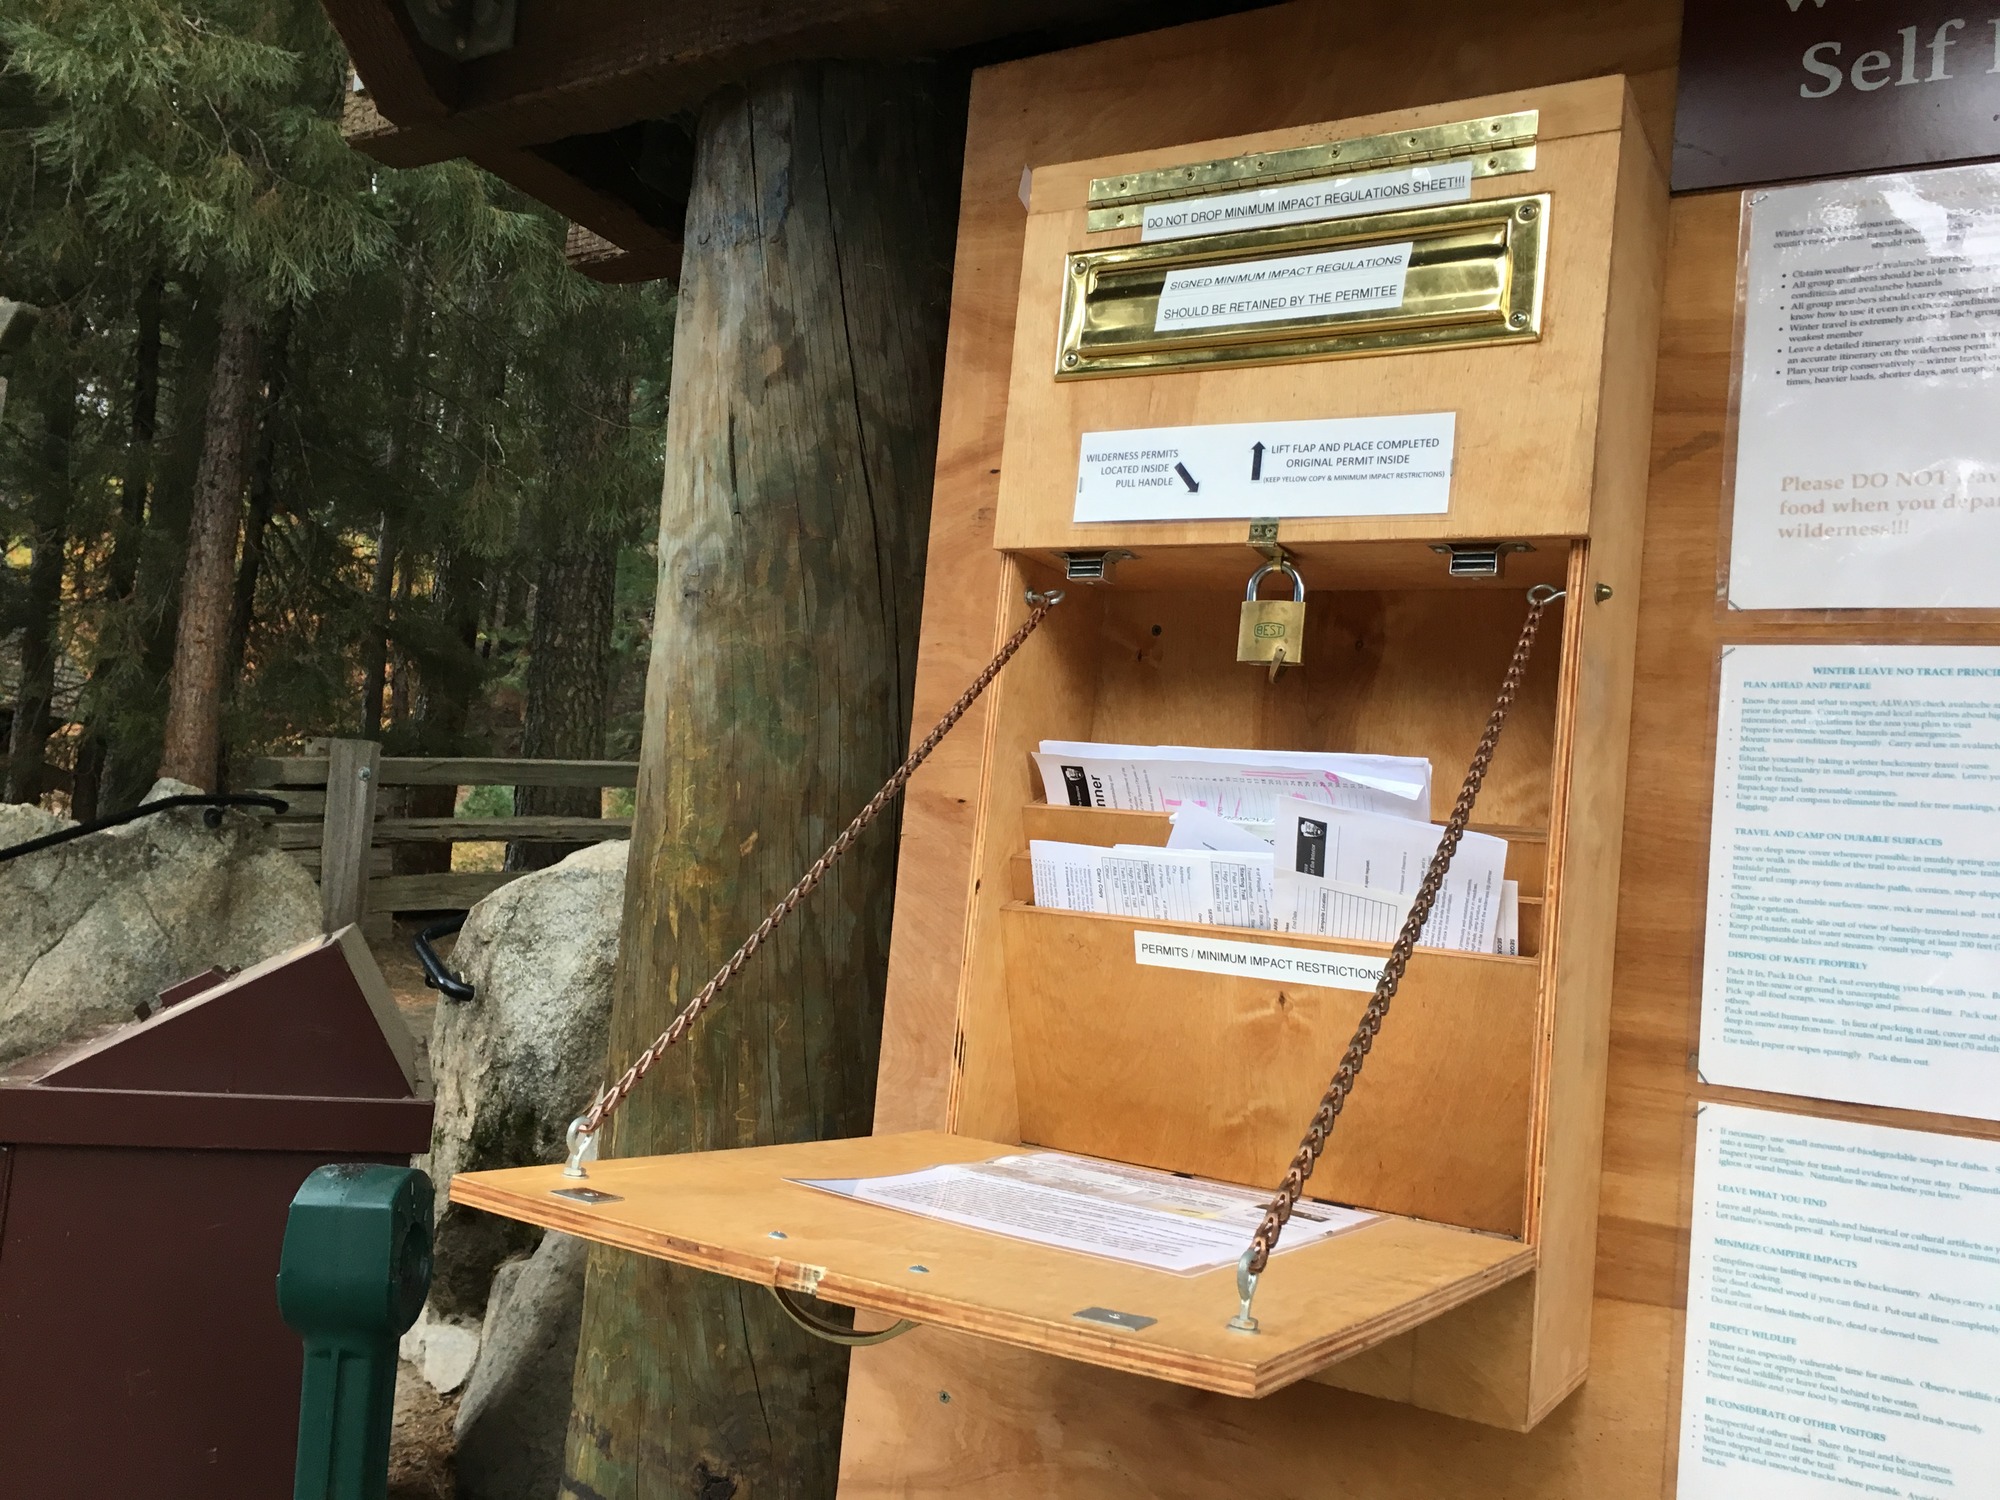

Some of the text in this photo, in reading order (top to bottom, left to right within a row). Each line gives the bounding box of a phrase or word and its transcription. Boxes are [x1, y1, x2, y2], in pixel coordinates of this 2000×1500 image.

[1800, 18, 1965, 98] Self
[1148, 176, 1465, 229] DO NOT DROP MINIMUM IMPACT REGULATIONS SHEET!!!
[1170, 255, 1403, 290] SIGNED MINIMUM IMPACT REGULATIONS
[1164, 285, 1397, 319] SHOULD BE RETAINED BY THE PERMITEE
[1087, 449, 1179, 462] WILDERNESS PERMITS
[1272, 438, 1439, 454] LIFT FLAP AND PLACE COMPLETED
[1101, 464, 1169, 475] LOCATED INSIDE
[1286, 454, 1410, 468] ORIGINAL PERMIT INSIDE
[1116, 477, 1173, 488] PULL HANDLE
[1263, 476, 1281, 484] (KEEP
[1282, 475, 1307, 483] YELLOW
[1396, 471, 1445, 479] RESTRICTIONS)
[1781, 476, 1844, 492] Please
[1852, 472, 1888, 489] DO
[1896, 470, 1949, 487] NOT
[1780, 499, 1825, 515] food
[1833, 498, 1889, 513] when
[1897, 497, 1935, 516] you
[1778, 520, 1909, 539] wilderness!!!
[1257, 625, 1282, 636] BEST
[1813, 667, 1856, 675] WINTER
[1859, 667, 1893, 676] LEAVE
[1896, 667, 1914, 676] NO
[1917, 668, 1954, 676] TRACE
[1744, 681, 1768, 689] PLAN
[1829, 682, 1871, 690] PREPARE
[1091, 774, 1106, 807] nner
[1735, 828, 1771, 837] TRAVEL
[1773, 830, 1795, 838] AND
[1797, 831, 1826, 840] CAMP
[1844, 834, 1890, 844] DURABLE
[1892, 836, 1943, 847] SURFACES
[1142, 943, 1189, 958] PERMITS
[1198, 951, 1247, 965] MINIMUM
[1250, 956, 1293, 970] IMPACT
[1296, 961, 1383, 981] RESTRICTIONS
[1728, 951, 1868, 970] DISPOSE OF WASTE PROPERLY
[1717, 1184, 1827, 1208] LEAVE WHAT YOU FIND
[1714, 1238, 1858, 1269] MINIMIZE CAMPFIRE IMPACTS
[1710, 1322, 1797, 1346] RESPECT WILDLIFE
[1706, 1396, 1886, 1442] BE CONSIDERATE OF OTHER VISITORS
